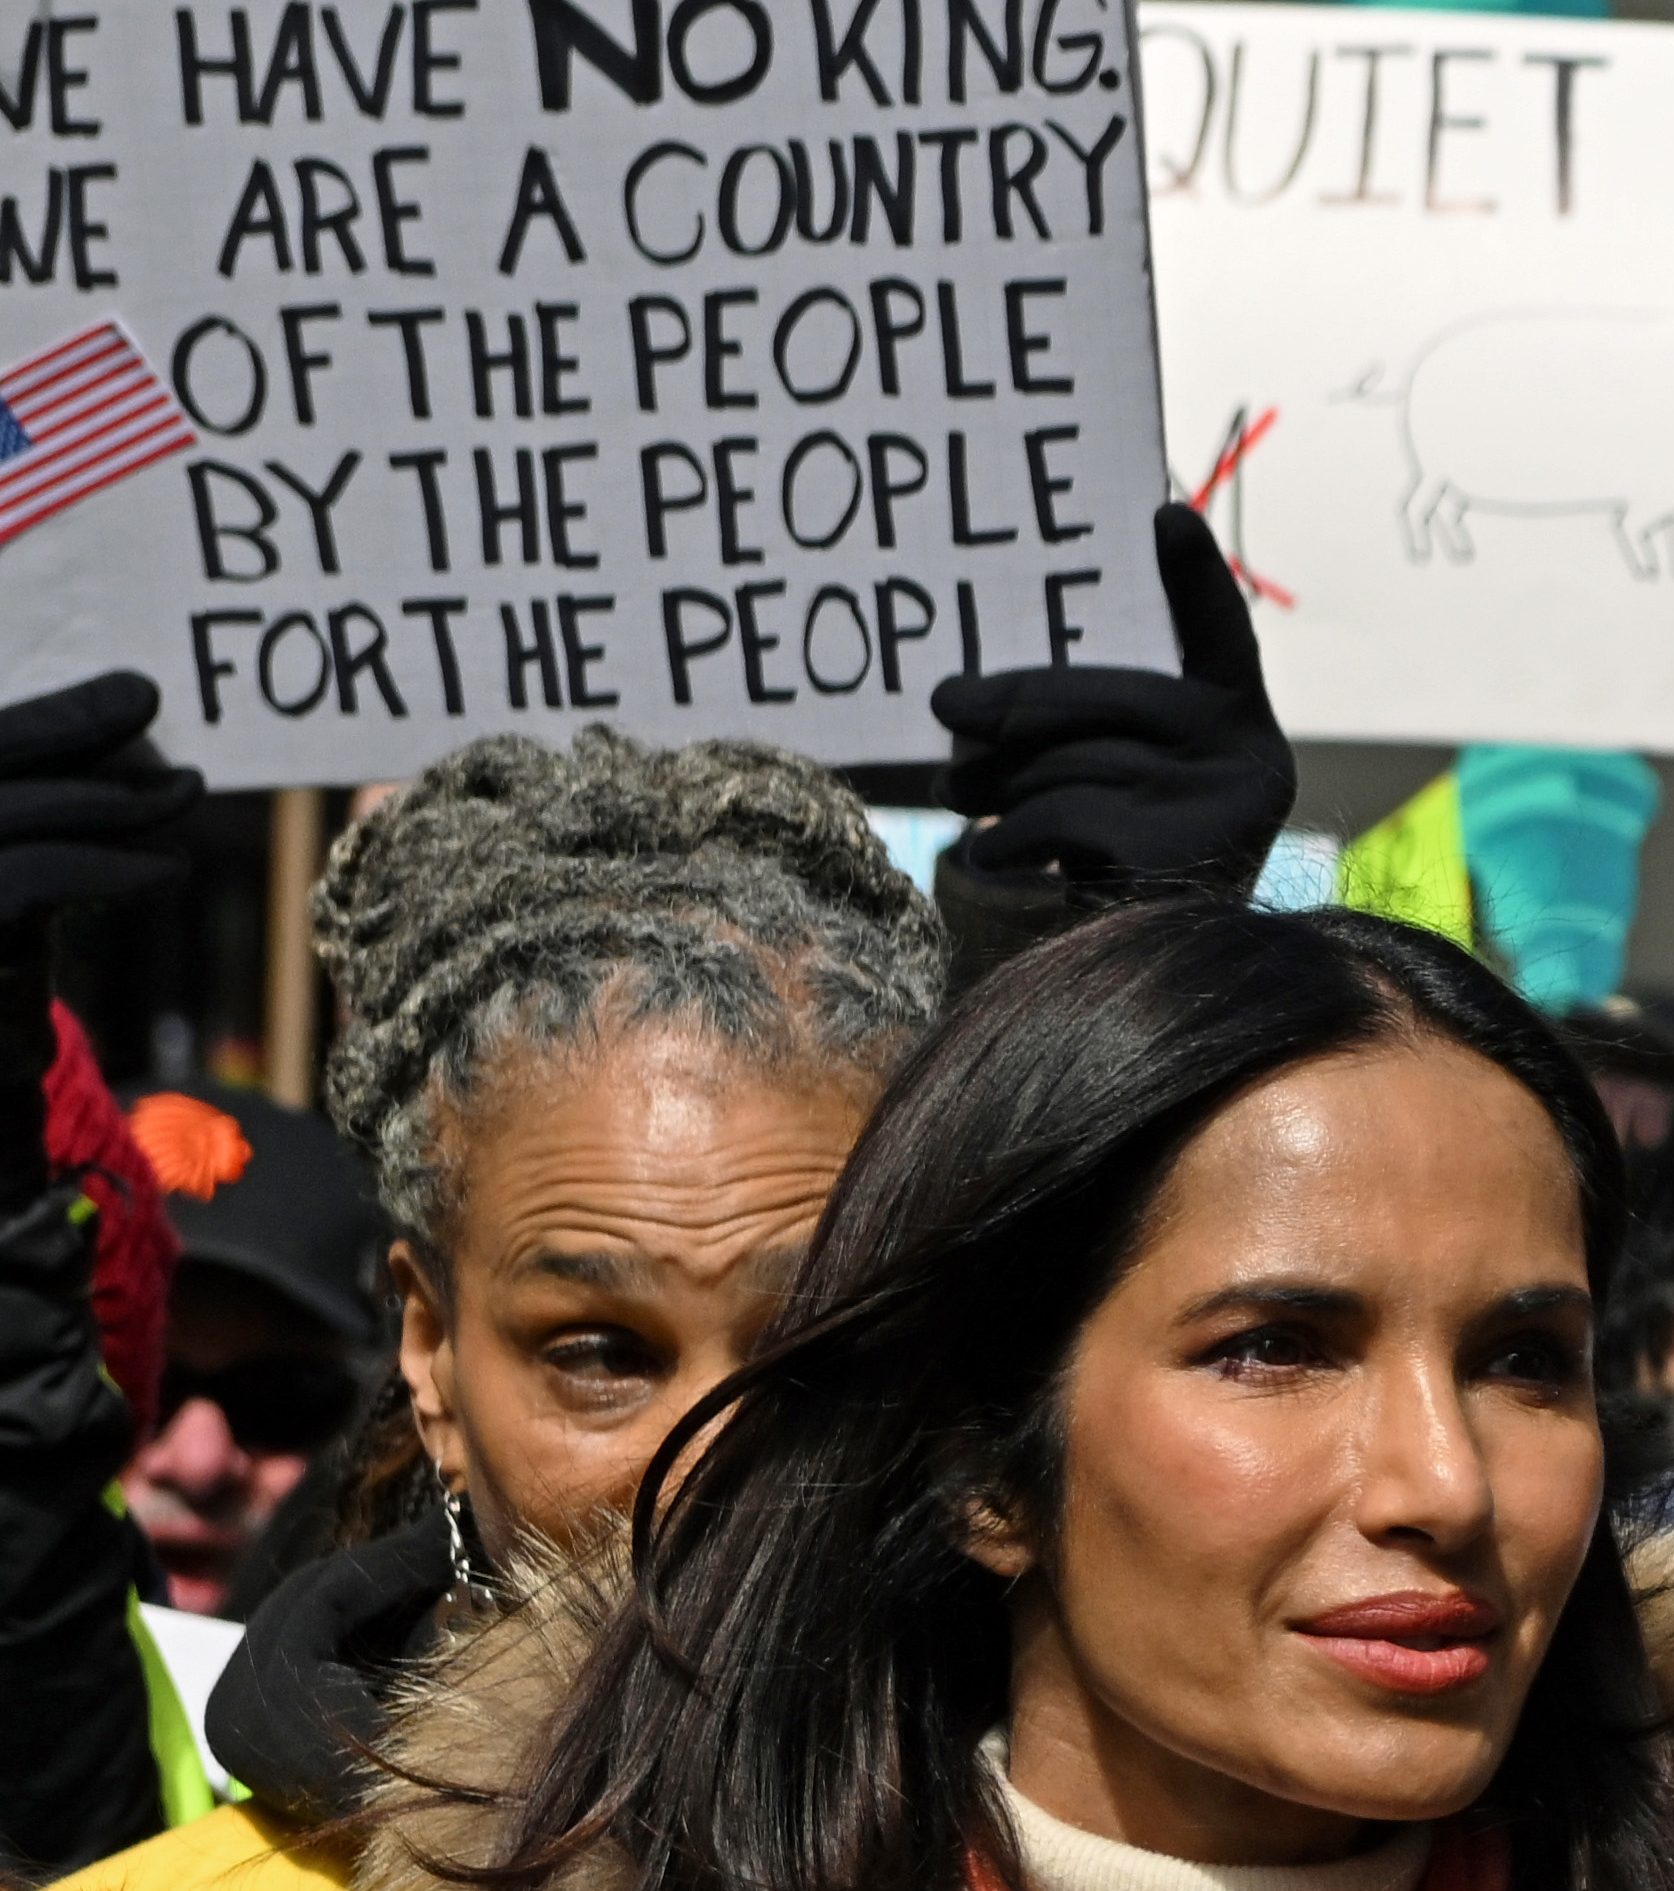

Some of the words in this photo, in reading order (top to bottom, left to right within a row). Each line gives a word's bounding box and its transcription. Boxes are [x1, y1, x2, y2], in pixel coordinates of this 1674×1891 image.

[176, 0, 478, 126] HAVE
[528, 0, 773, 114] NO
[810, 0, 1121, 107] KING.
[1140, 24, 1612, 215] QUIET
[217, 147, 436, 279] ARE
[498, 146, 586, 277] A
[623, 115, 1126, 267] COUNTRY
[171, 303, 342, 438] OF
[367, 301, 592, 420] THE
[628, 278, 1075, 412] PEOPLE
[186, 450, 361, 583] BY
[388, 443, 600, 573] THE
[640, 425, 1094, 566] PEOPLE
[190, 601, 409, 725] FOR
[401, 594, 620, 717] THE
